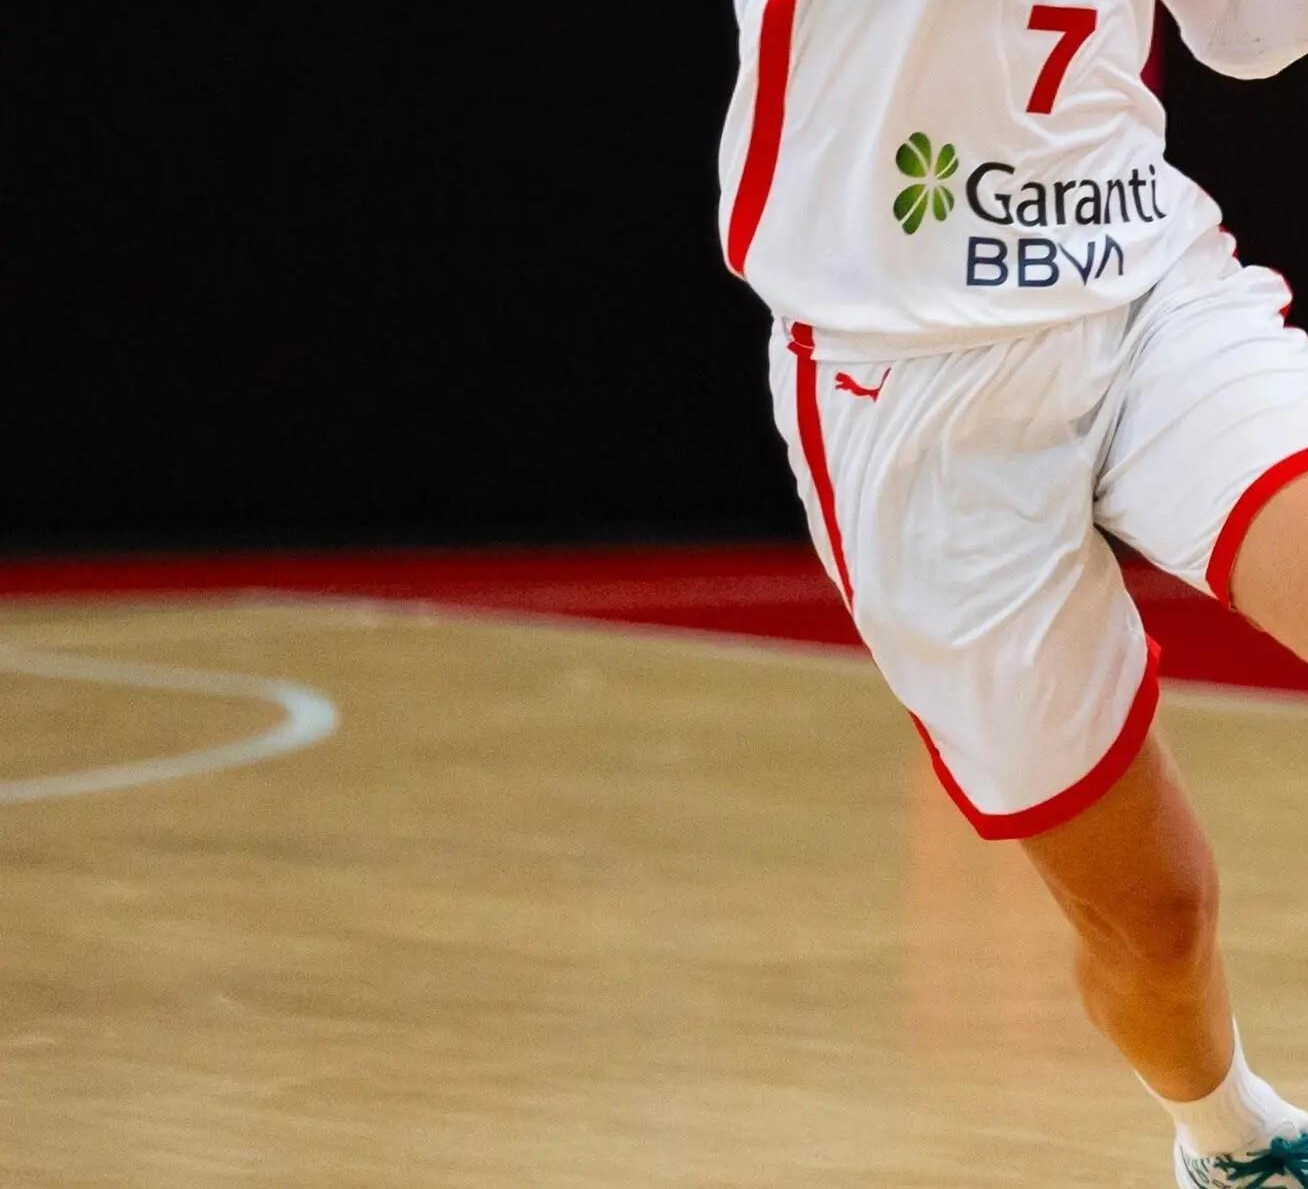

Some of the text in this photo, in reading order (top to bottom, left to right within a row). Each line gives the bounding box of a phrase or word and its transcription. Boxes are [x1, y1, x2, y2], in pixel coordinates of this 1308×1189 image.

[1025, 4, 1098, 115] 7
[965, 161, 1168, 228] Garanti
[965, 233, 1125, 289] BBVA
